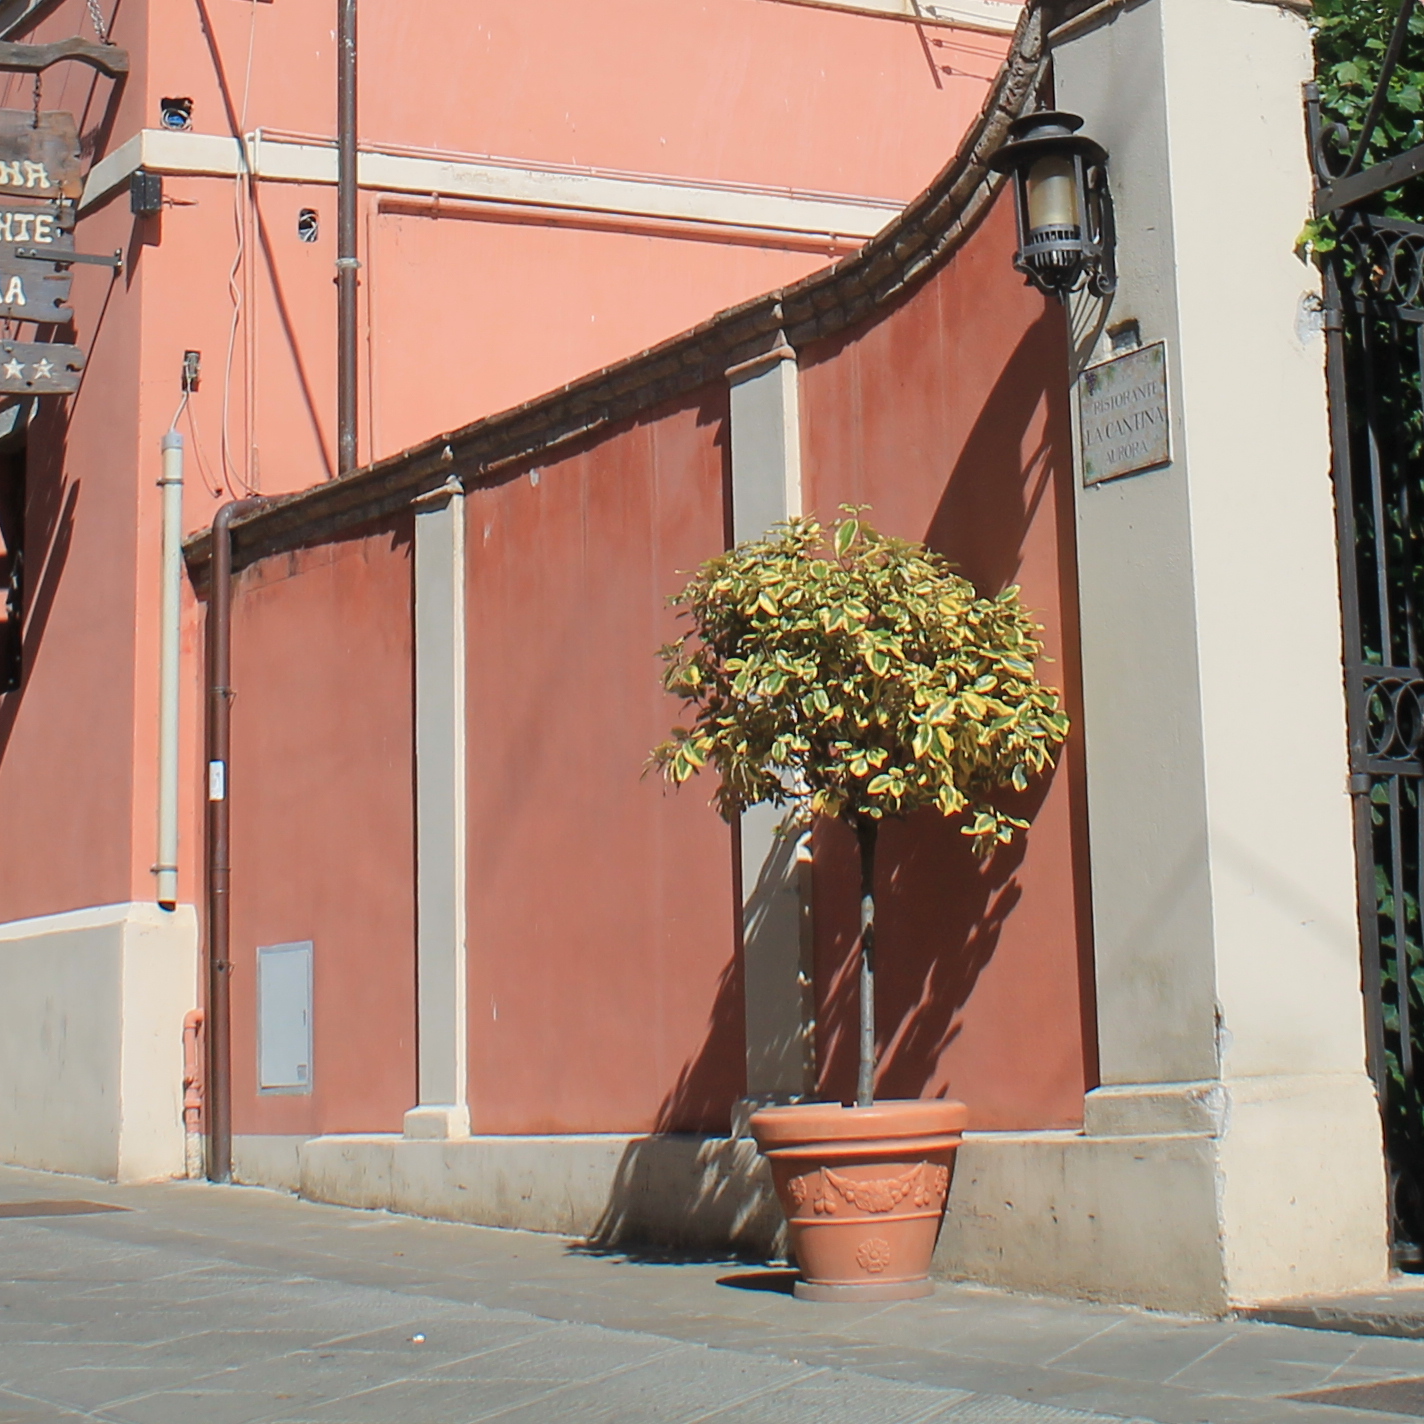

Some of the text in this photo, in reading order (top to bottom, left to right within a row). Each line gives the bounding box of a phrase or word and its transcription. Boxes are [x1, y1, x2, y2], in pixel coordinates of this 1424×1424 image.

[1093, 380, 1157, 415] RISTORANTE
[1105, 406, 1165, 439] CANTINA
[1106, 440, 1149, 465] AURORA
